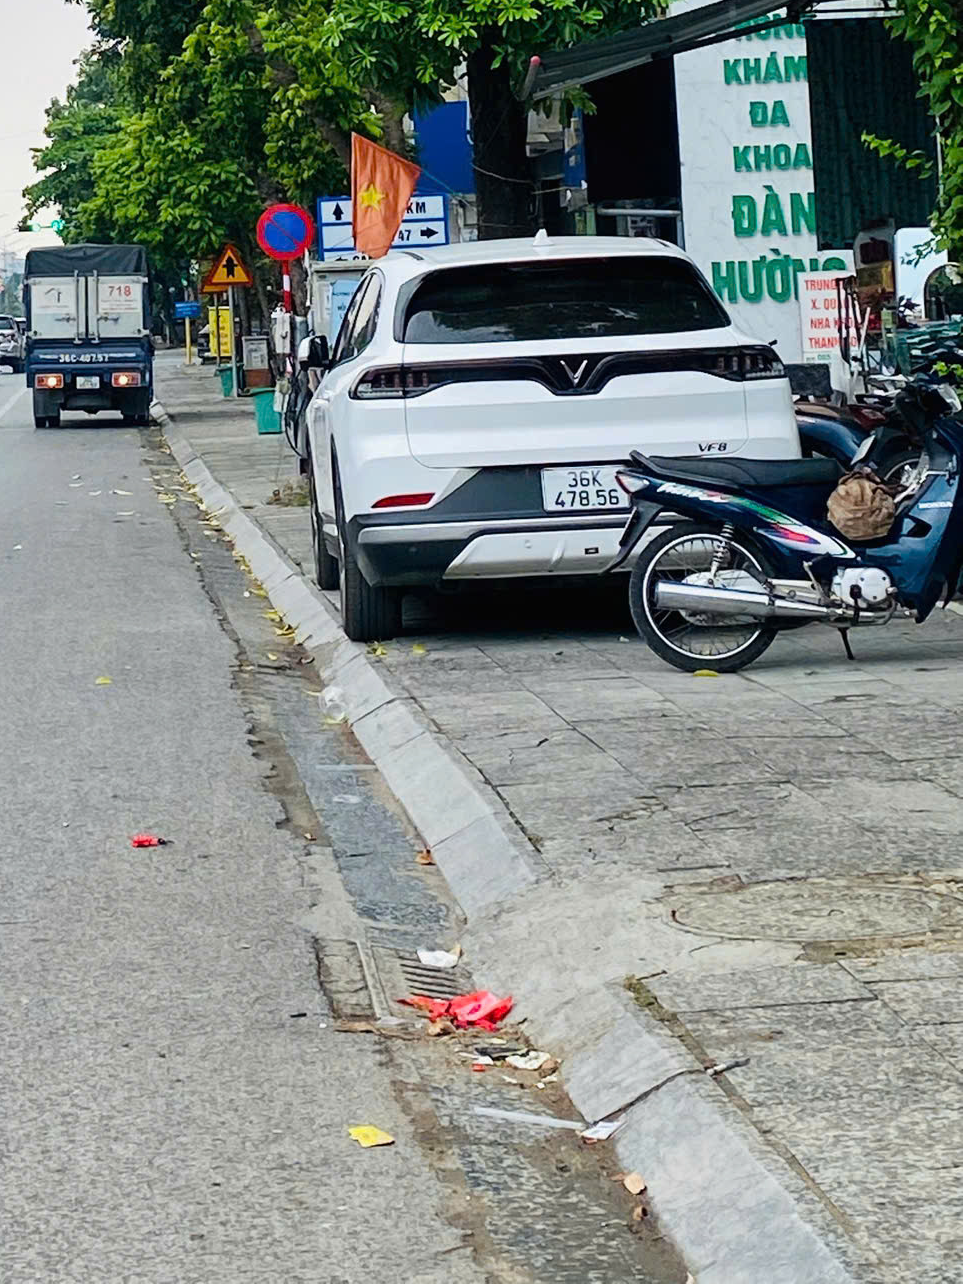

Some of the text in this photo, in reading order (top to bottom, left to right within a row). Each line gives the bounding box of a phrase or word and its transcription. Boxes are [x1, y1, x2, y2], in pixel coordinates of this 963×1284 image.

[723, 51, 808, 86] KHÁM
[748, 100, 790, 128] ĐA
[733, 143, 813, 173] KHOA
[732, 185, 816, 237] ĐÀN
[108, 285, 131, 297] 718
[568, 470, 603, 488] 36K
